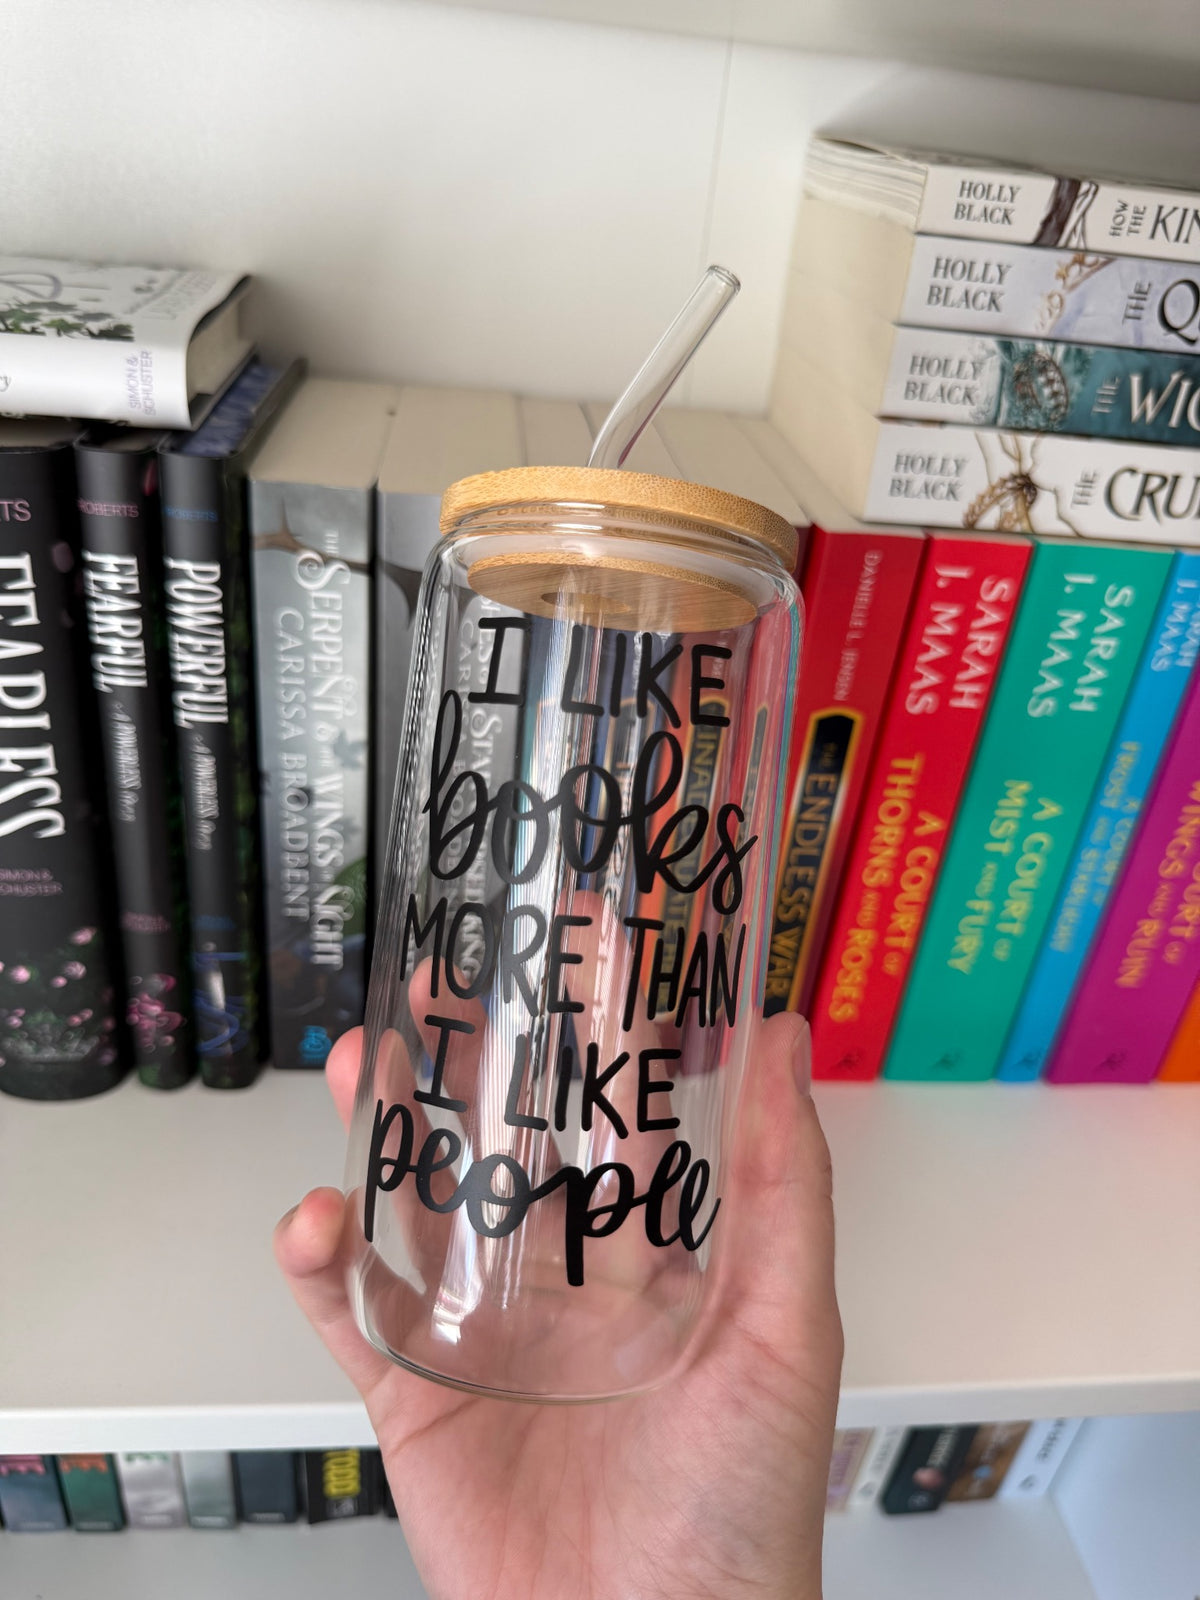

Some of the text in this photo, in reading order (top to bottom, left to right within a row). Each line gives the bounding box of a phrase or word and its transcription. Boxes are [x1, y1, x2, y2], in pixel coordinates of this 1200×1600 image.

[953, 203, 1015, 226] BLACK
[959, 179, 1021, 204] HOLLY
[1108, 199, 1129, 237] HOW
[1127, 205, 1147, 236] THE
[926, 285, 1005, 313] BLACK
[932, 256, 1012, 286] HOLLY
[1122, 279, 1153, 325] THE
[140, 350, 157, 417] SCHUSTER
[904, 380, 979, 407] BLACK
[909, 354, 986, 381] HOLLY
[888, 478, 963, 502] BLACK
[894, 453, 968, 478] HOLLY
[82, 551, 148, 693] FEARFUL
[163, 556, 229, 729] POWERFUL
[294, 549, 358, 720] SERPENT
[904, 601, 965, 716] MAAS
[948, 574, 1015, 711] SARAH
[1027, 607, 1088, 718] MAAS
[1069, 582, 1137, 713] SARAH
[1150, 601, 1193, 673] MAAS
[468, 616, 531, 706] I
[561, 625, 733, 728] LIKE
[275, 607, 310, 922] CARISSA BROADBENT
[422, 689, 759, 915] books
[311, 771, 345, 867] WINGS
[777, 771, 838, 922] ENDLESS
[862, 752, 926, 889] THORNS
[913, 810, 948, 837] A
[983, 778, 1034, 857] MIST
[1030, 796, 1064, 822] A
[884, 845, 941, 950] COURT
[996, 831, 1055, 937] COURT
[400, 893, 592, 1017] MORE
[623, 917, 747, 1032] THAN
[765, 920, 803, 999] WAR
[828, 927, 877, 1023] ROSES
[946, 898, 996, 975] FURY
[1114, 917, 1165, 989] RUIN
[413, 1014, 682, 1139] I LIKE
[364, 1098, 722, 1287] people
